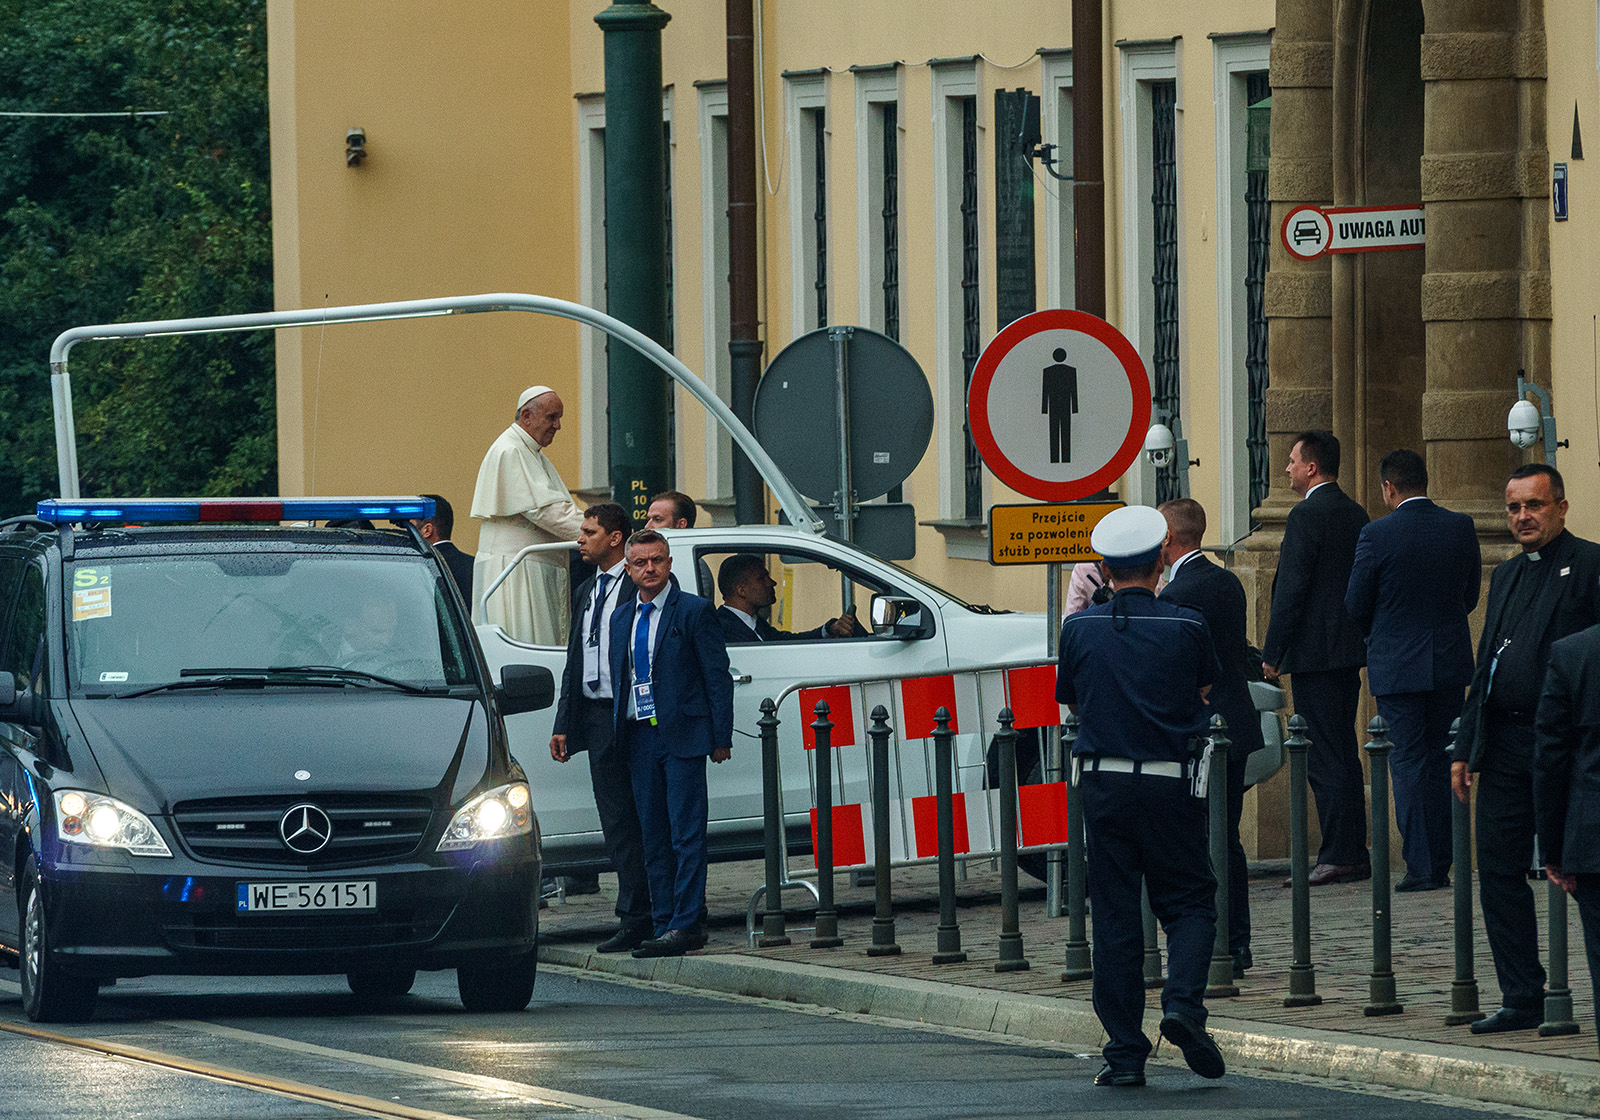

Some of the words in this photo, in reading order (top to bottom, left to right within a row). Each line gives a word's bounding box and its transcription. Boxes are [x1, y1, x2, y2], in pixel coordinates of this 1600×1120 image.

[1339, 220, 1395, 240] UWAGA
[631, 480, 648, 491] PL
[633, 495, 648, 505] 10
[633, 509, 648, 520] 02
[1032, 512, 1085, 525] Przejście
[1010, 532, 1024, 541] za
[998, 545, 1031, 557] służb
[1034, 544, 1097, 559] porządko
[253, 885, 288, 909] WE
[298, 883, 371, 908] 56151
